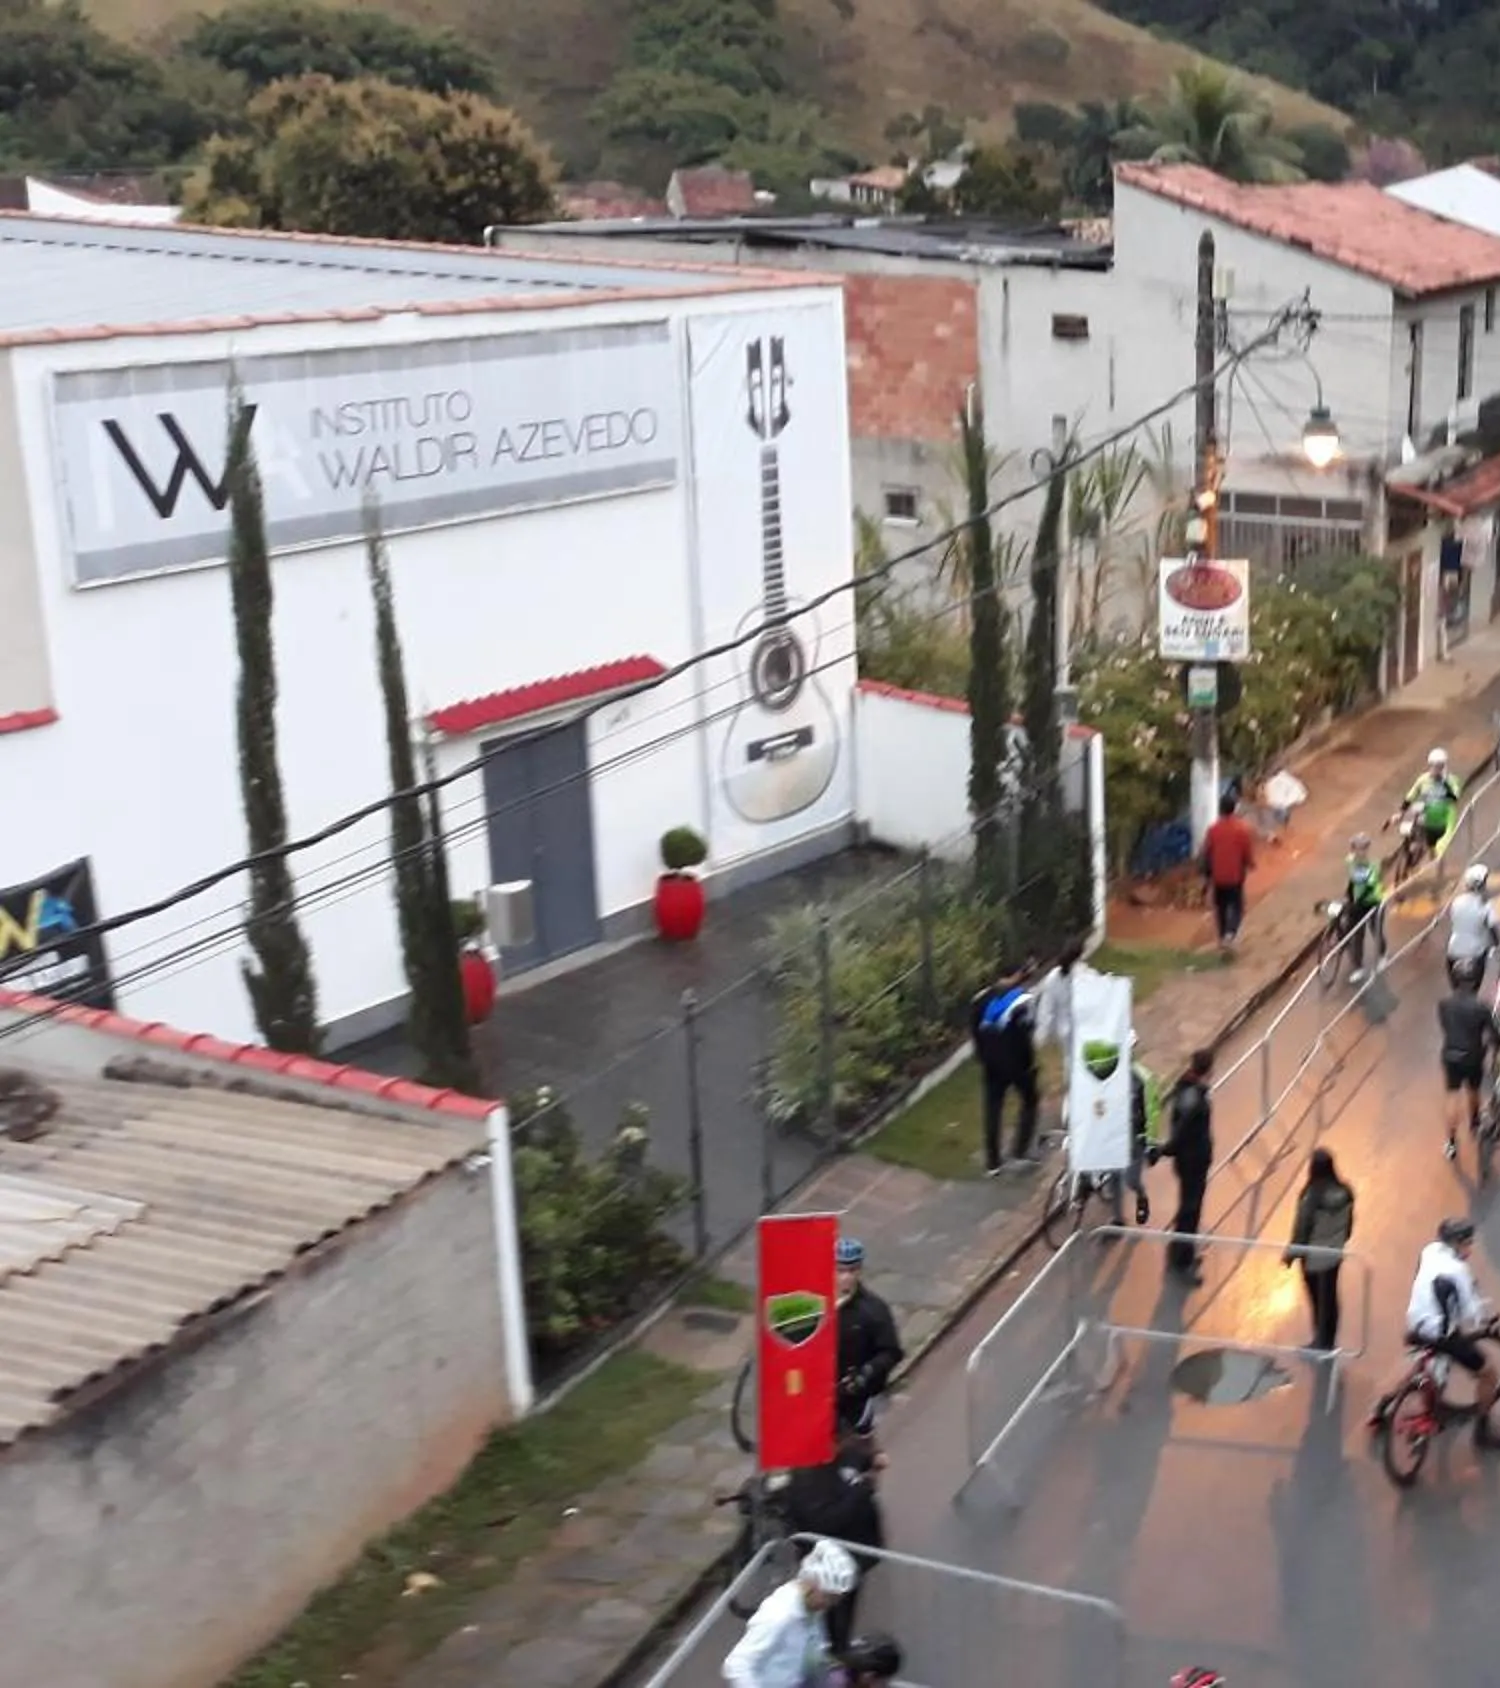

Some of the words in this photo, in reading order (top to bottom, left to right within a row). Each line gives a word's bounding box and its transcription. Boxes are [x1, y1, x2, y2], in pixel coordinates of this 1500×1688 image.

[310, 389, 472, 439] INSTITUTO
[319, 431, 479, 490] WALDIR
[491, 406, 659, 467] AZEVEDO
